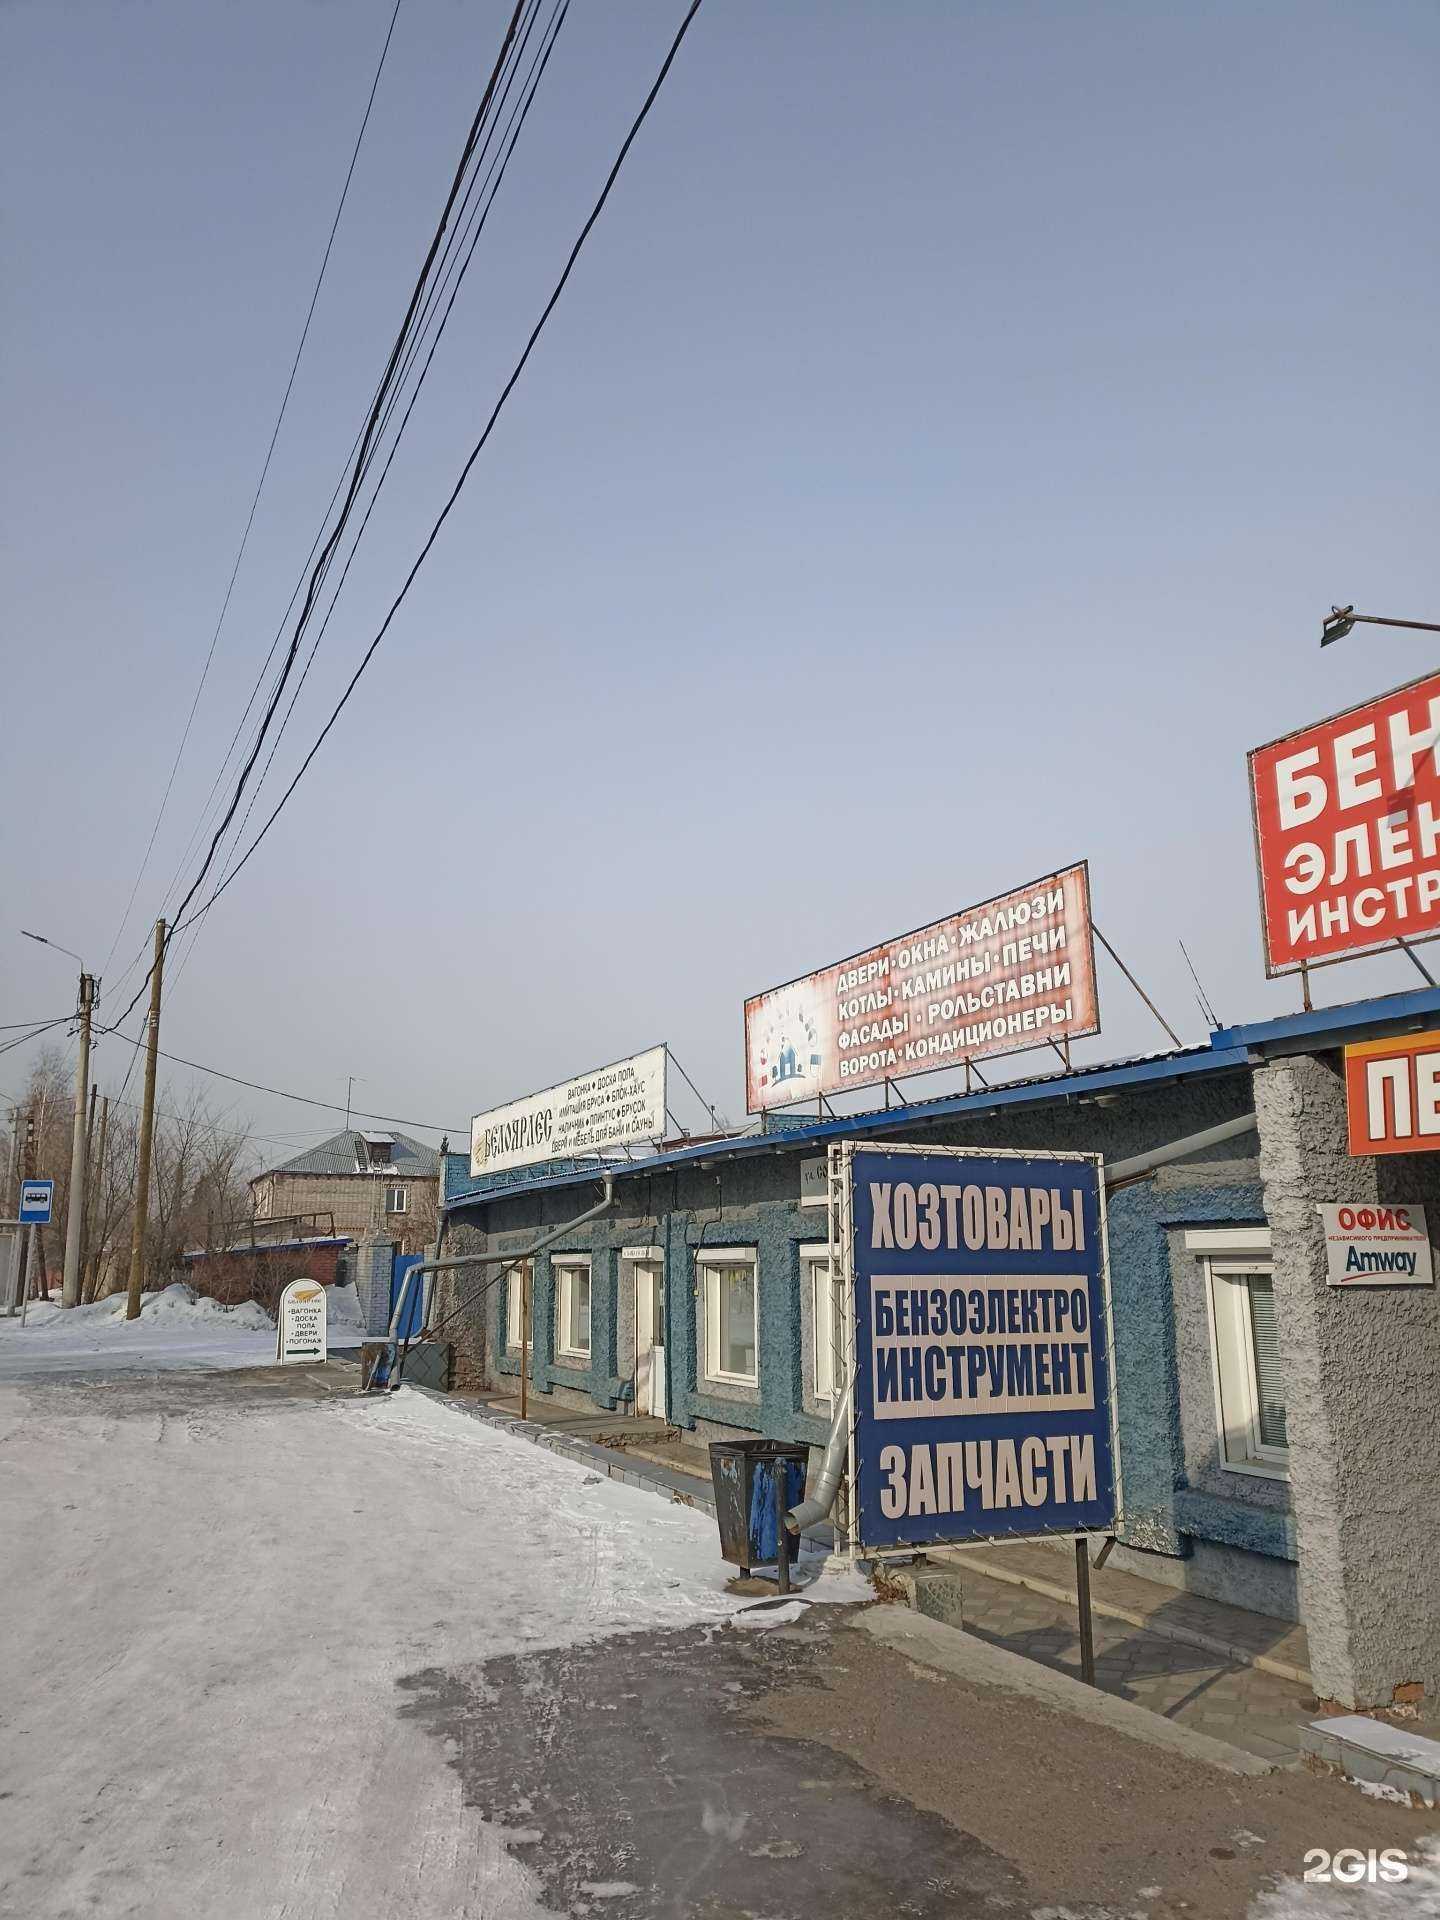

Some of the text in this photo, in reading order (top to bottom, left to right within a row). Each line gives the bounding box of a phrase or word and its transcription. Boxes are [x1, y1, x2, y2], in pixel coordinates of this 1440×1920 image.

[837, 887, 1066, 996] ДВЕРИ ОКНА ЖАЛЮЗИ
[838, 925, 1068, 1021] КОТЛЫ КАМИНЫ ПЕЧИ
[837, 962, 1072, 1051] ФАСАДЫ РОЛЬСТАВНИ
[839, 998, 1074, 1078] ВОРОТА КОНДИЦИОНЕРЫ
[586, 1095, 605, 1111] БРУСА
[597, 1073, 617, 1090] ДОСКА
[621, 1100, 646, 1118] БРУСОК
[631, 1115, 655, 1133] САУНЫ
[870, 1182, 1086, 1251] ХОЗТОВАРЫ
[1338, 1207, 1412, 1231] ОФИС
[1346, 1245, 1417, 1277] Amway
[874, 1287, 1088, 1337] БЕНЗОЭЛЕКТРО
[876, 1342, 1090, 1403] ИНСТРУМЕНТ
[879, 1434, 1098, 1520] ЗАПЧАСТИ
